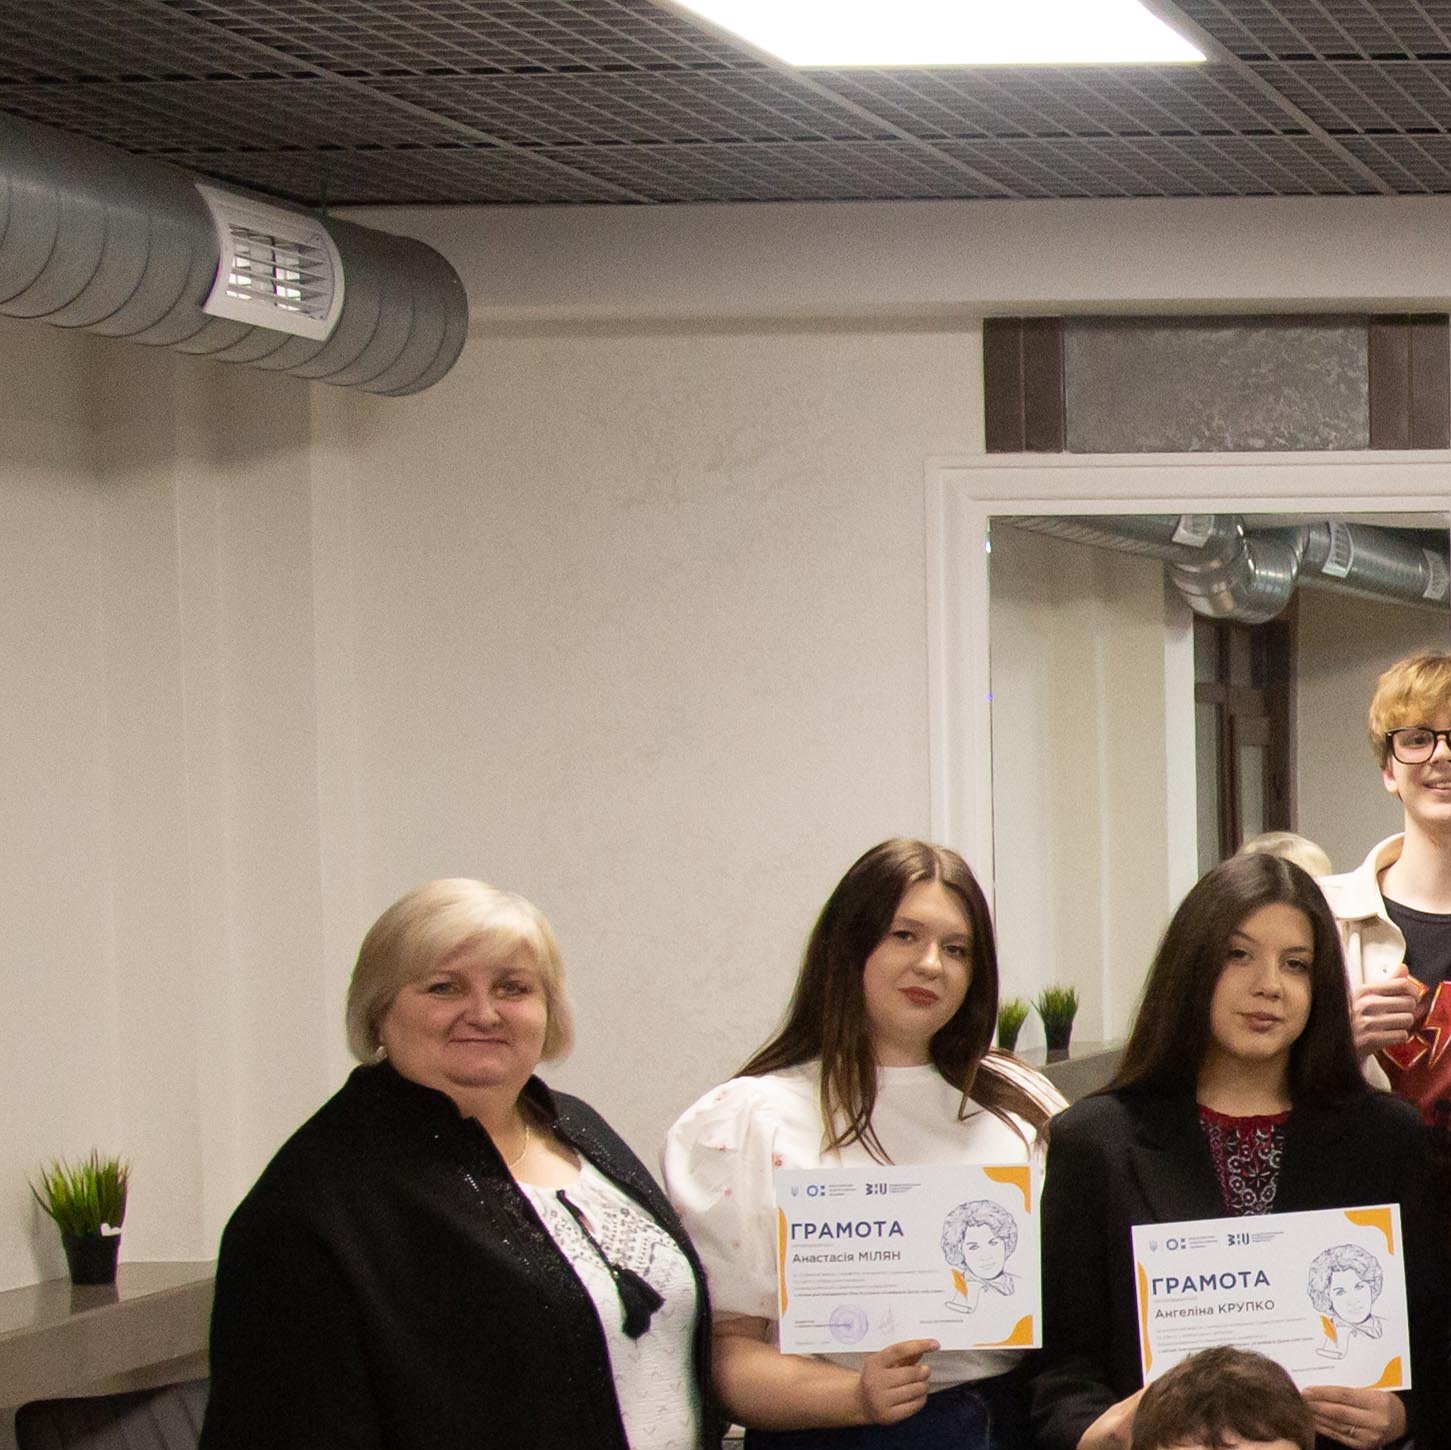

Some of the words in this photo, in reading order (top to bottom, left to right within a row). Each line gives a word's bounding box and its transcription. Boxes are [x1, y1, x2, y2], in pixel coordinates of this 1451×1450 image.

[791, 1220, 904, 1239] ГРАМОТА
[792, 1252, 854, 1263] Анастасія
[858, 1250, 901, 1261] МІЛЯН
[1152, 1270, 1271, 1295] ГРАМОТА
[1154, 1306, 1214, 1320] Ангеліна
[1218, 1299, 1275, 1313] КРУПКО
